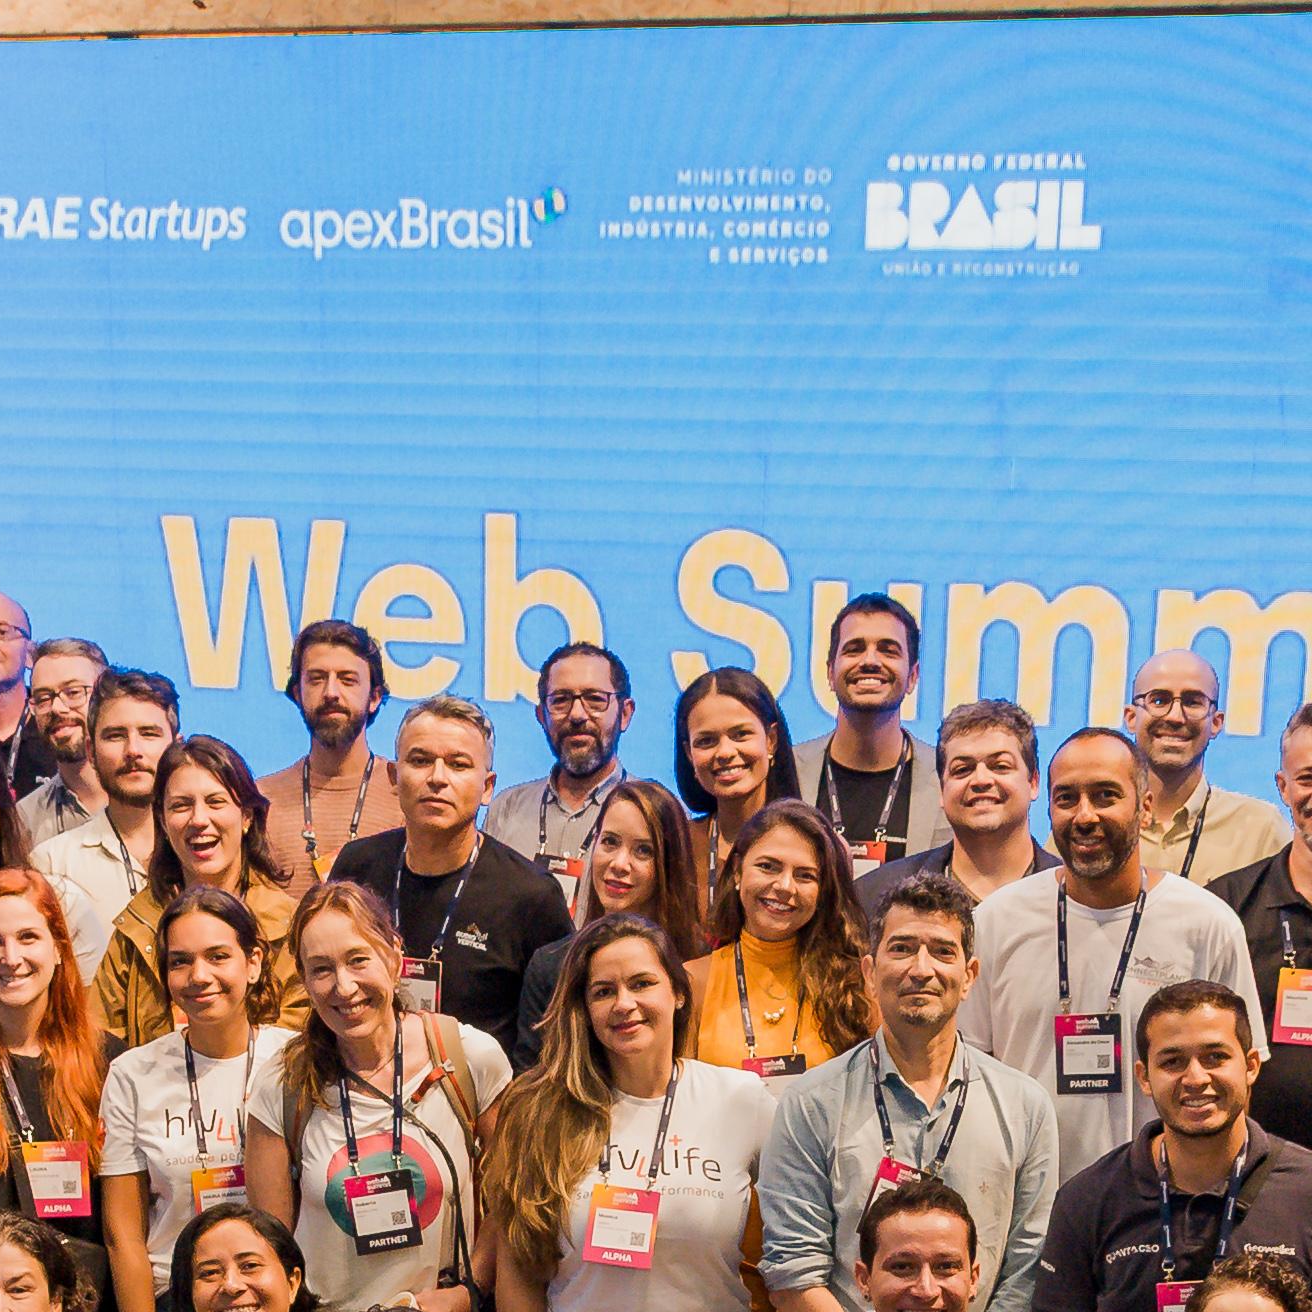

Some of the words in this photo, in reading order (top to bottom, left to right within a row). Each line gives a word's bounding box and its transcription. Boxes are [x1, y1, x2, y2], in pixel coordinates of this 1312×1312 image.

[887, 154, 986, 172] GOVERNO
[993, 152, 1087, 171] FEDERAL
[676, 166, 797, 186] MINISTÉRIO
[804, 168, 833, 185] DO
[628, 194, 832, 215] DESENVOLVIMENTO,
[89, 197, 248, 252] Startups
[865, 180, 1102, 251] BRASIL
[280, 196, 534, 261] apexBrasil
[599, 218, 716, 241] INDÚSTRIA,
[723, 218, 832, 241] COMÉRCIO
[708, 247, 721, 265] E
[728, 246, 830, 269] SERVIÇOS
[881, 260, 934, 278] UNIÃO
[952, 260, 1081, 280] RECONSTRUÇÃO
[161, 512, 605, 703] Web
[1069, 1079, 1109, 1089] PARTNER
[43, 1204, 72, 1214] ALPHA
[369, 1234, 408, 1249] PARTNER
[601, 1250, 632, 1263] ALPHA
